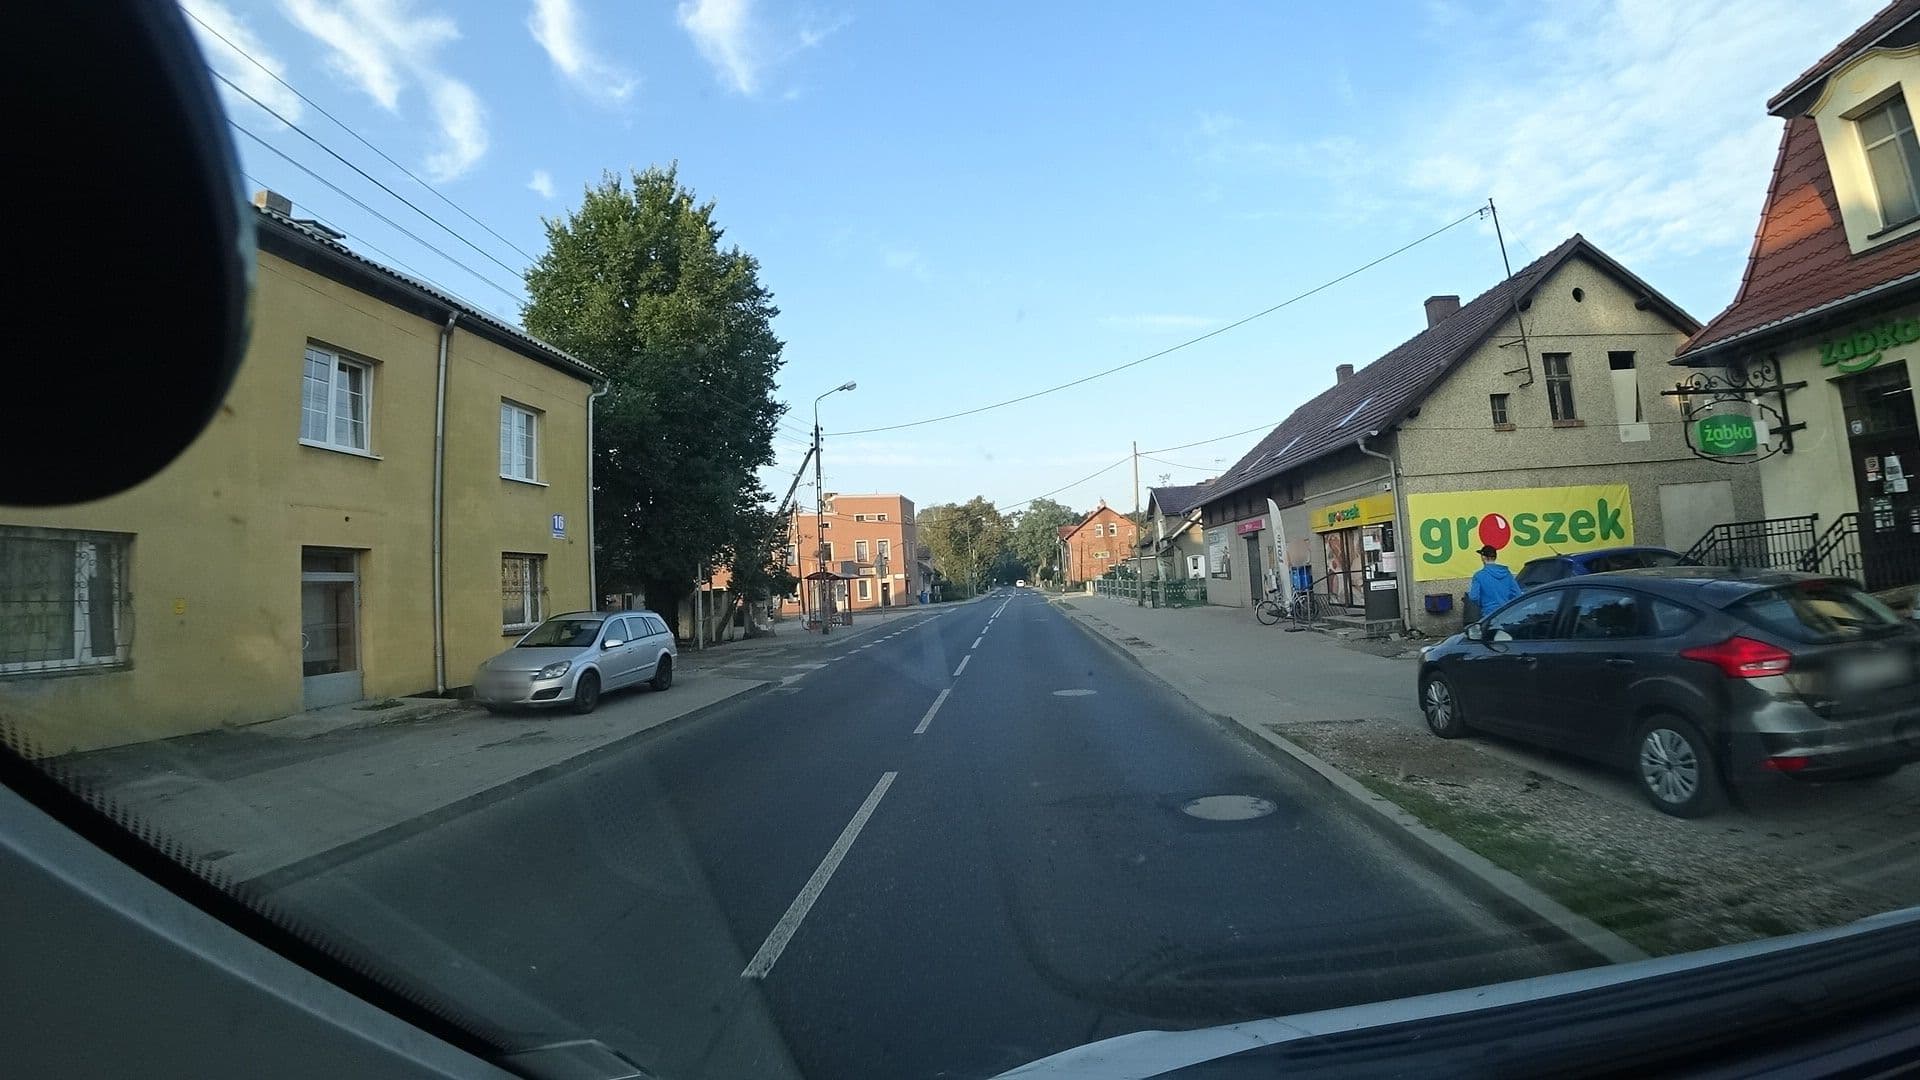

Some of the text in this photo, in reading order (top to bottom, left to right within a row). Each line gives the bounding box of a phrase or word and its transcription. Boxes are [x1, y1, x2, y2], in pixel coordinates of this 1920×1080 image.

[1704, 424, 1753, 442] żabka
[552, 515, 564, 529] 16
[1419, 497, 1625, 564] groszek
